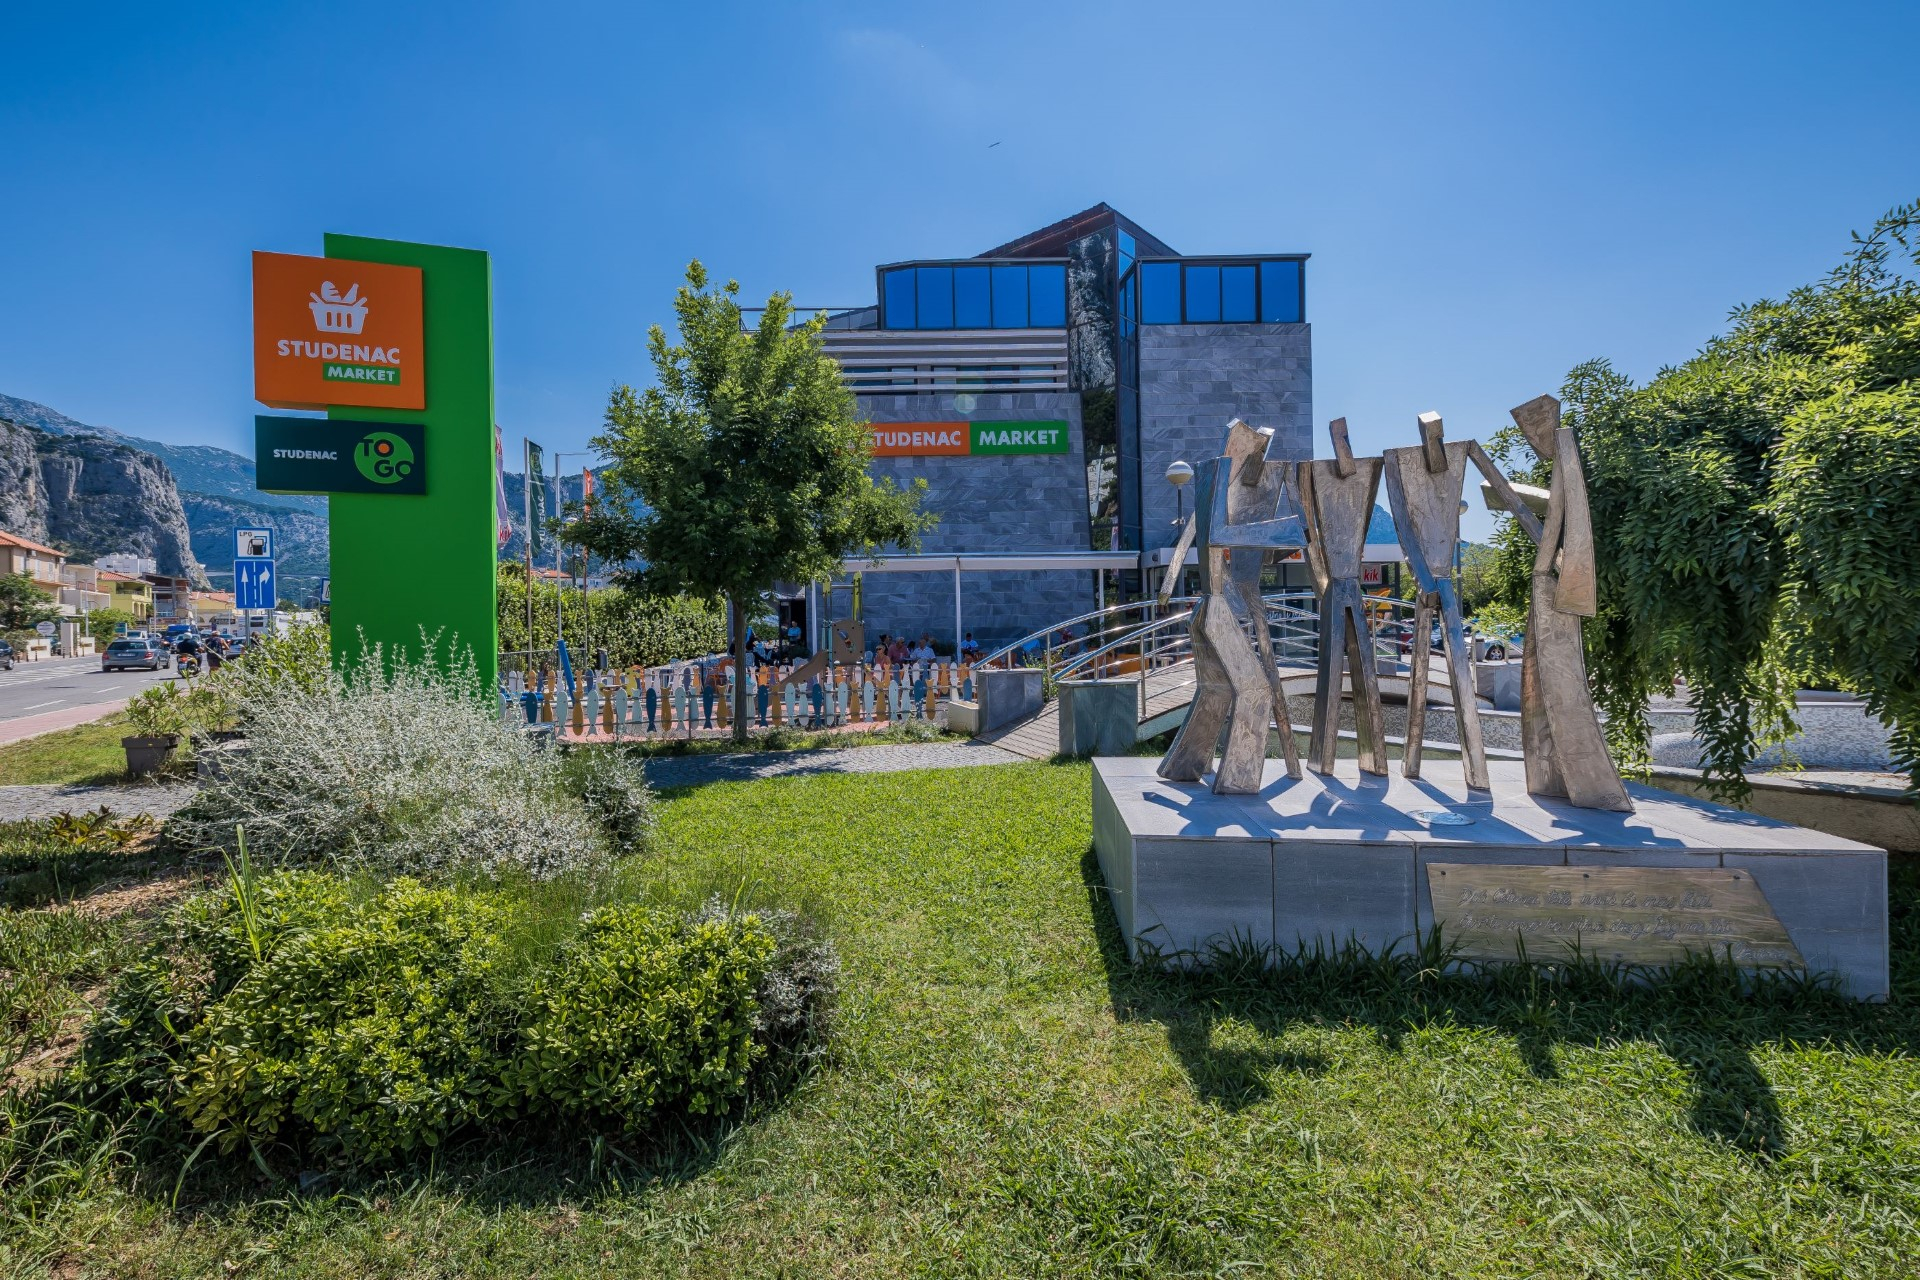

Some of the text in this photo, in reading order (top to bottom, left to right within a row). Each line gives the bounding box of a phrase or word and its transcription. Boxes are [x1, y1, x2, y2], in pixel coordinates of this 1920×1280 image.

[277, 339, 401, 364] STUDENAC
[327, 366, 396, 382] MARKET
[867, 429, 1060, 447] TUDENAC MARKET
[273, 448, 338, 461] STUDENAC
[358, 438, 395, 458] TO
[373, 460, 415, 480] GO
[1363, 568, 1379, 581] kik
